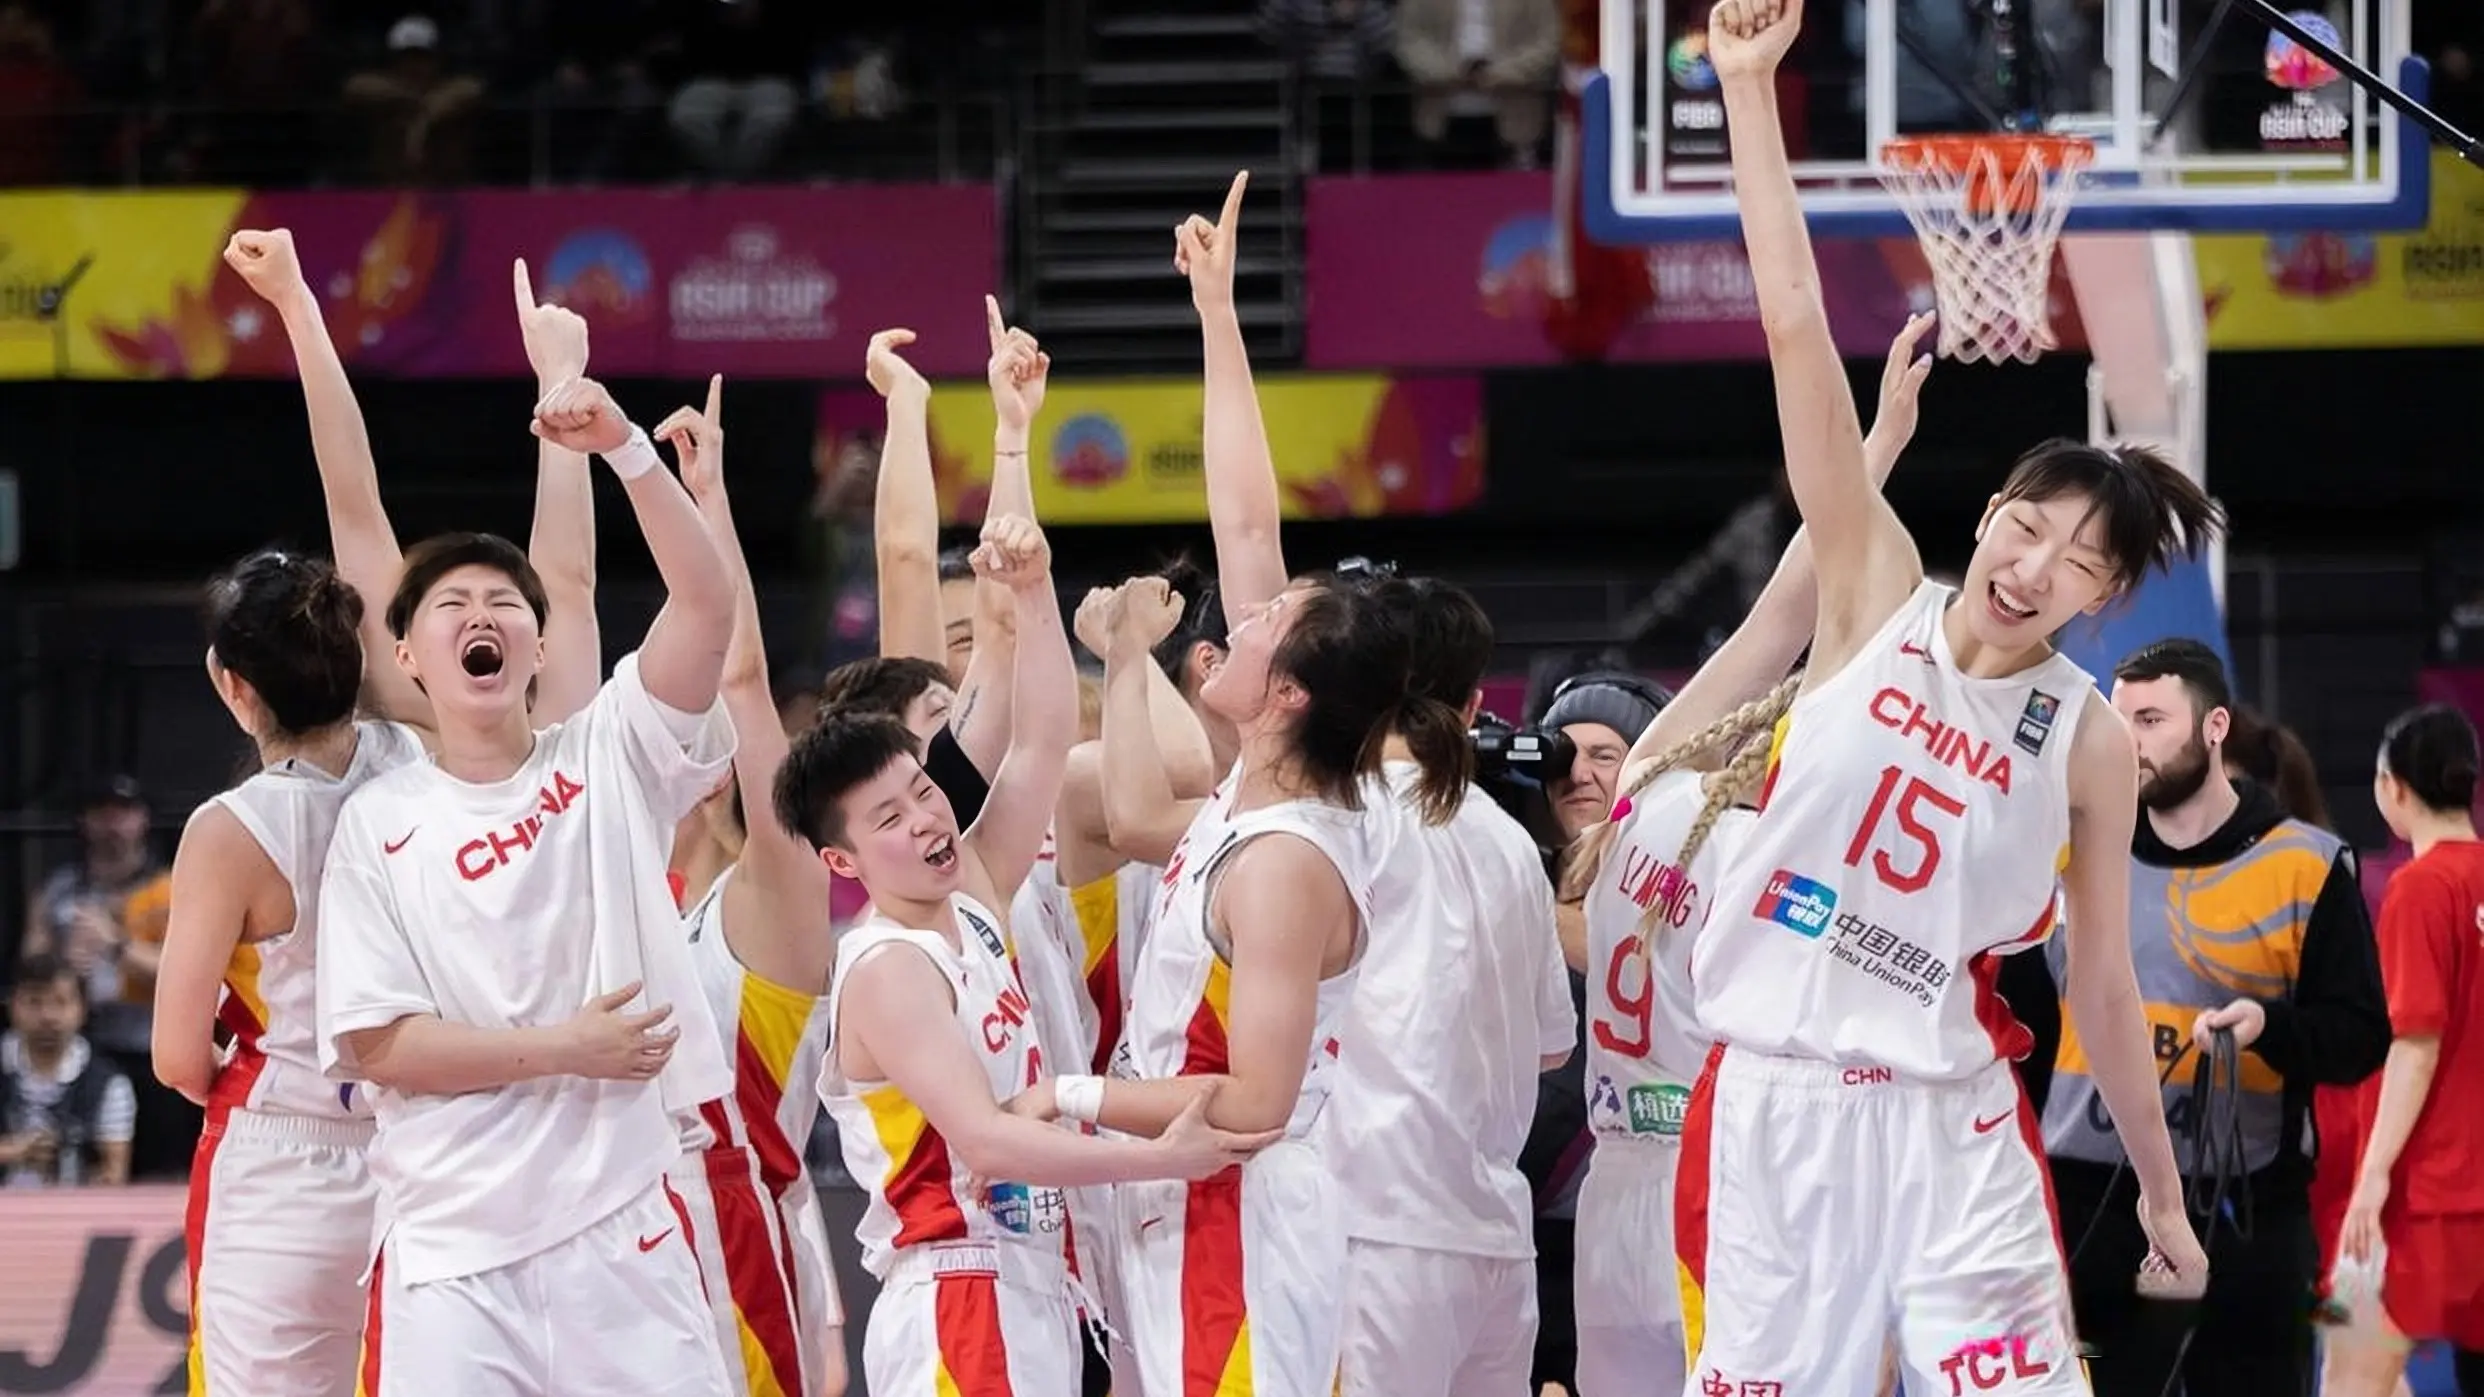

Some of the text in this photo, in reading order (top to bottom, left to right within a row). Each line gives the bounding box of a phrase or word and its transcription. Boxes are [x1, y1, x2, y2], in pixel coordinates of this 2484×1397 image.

[1869, 687, 2012, 796] CHINA
[1844, 765, 1968, 894] 15
[1768, 880, 1832, 918] UnionPay
[1593, 934, 1654, 1059] 9
[1827, 936, 1937, 1008] China UnionPay
[1843, 1066, 1892, 1085] CHN
[1033, 1187, 1065, 1216] 中
[1939, 1336, 2050, 1397] TCL
